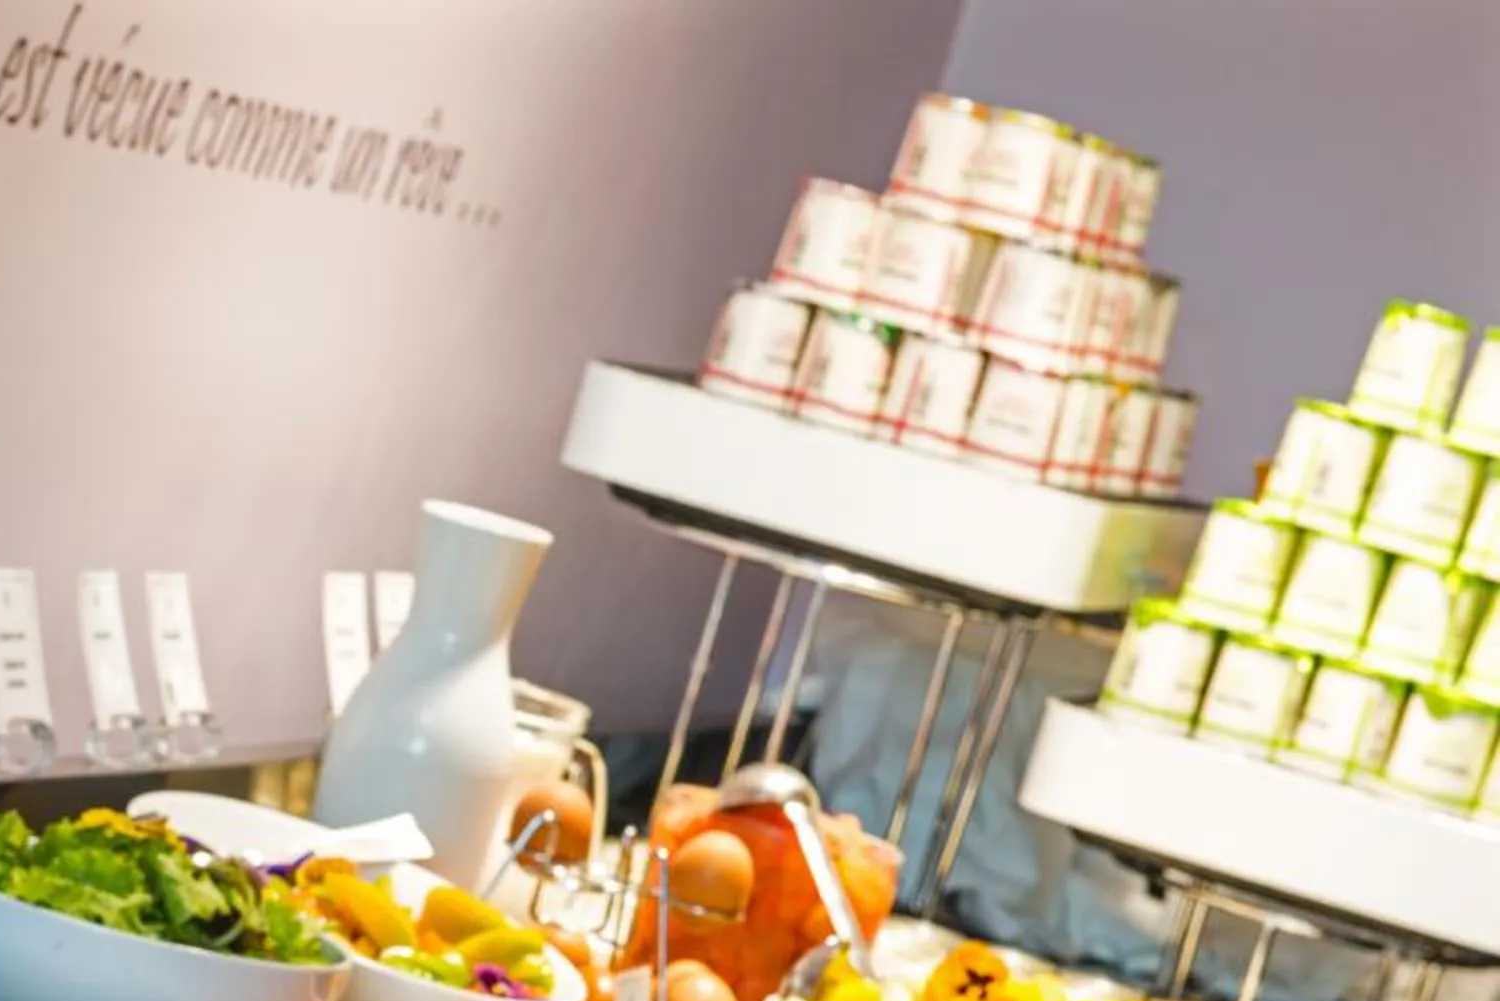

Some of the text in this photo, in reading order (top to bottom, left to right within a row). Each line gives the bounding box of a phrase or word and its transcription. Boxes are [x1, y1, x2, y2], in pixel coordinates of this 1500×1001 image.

[63, 24, 191, 157] vécue
[184, 88, 339, 189] comme
[329, 125, 391, 203] un
